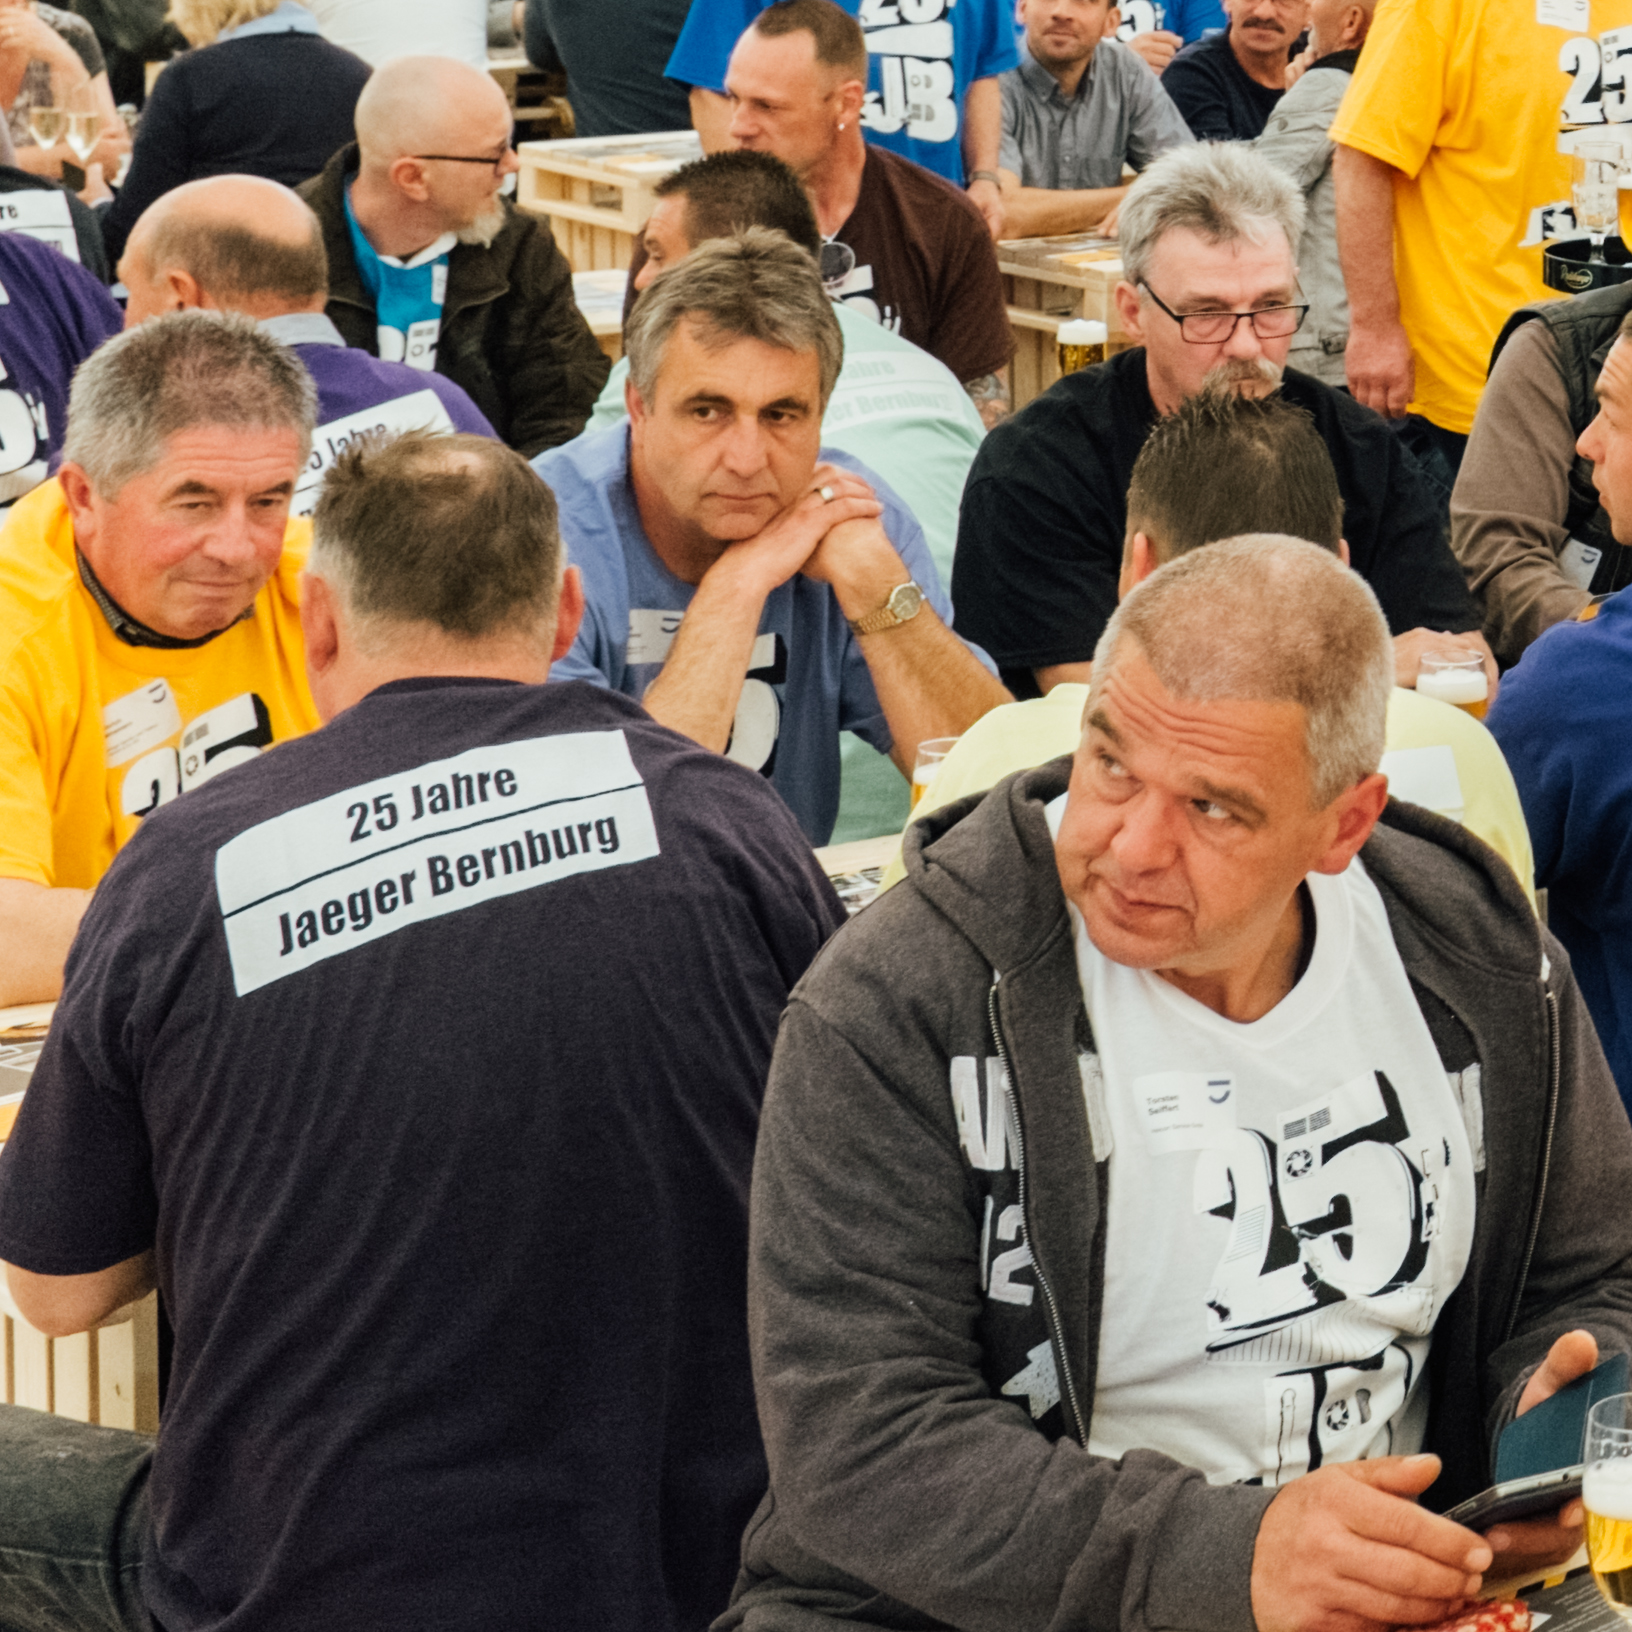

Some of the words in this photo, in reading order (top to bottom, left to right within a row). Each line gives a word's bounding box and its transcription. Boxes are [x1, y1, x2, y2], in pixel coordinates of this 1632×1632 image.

[843, 360, 895, 380] ahre
[347, 794, 398, 843] 25
[411, 768, 518, 820] Jahre
[278, 869, 417, 957] Jaeger
[427, 815, 620, 898] Bernburg
[1193, 1070, 1420, 1331] 25
